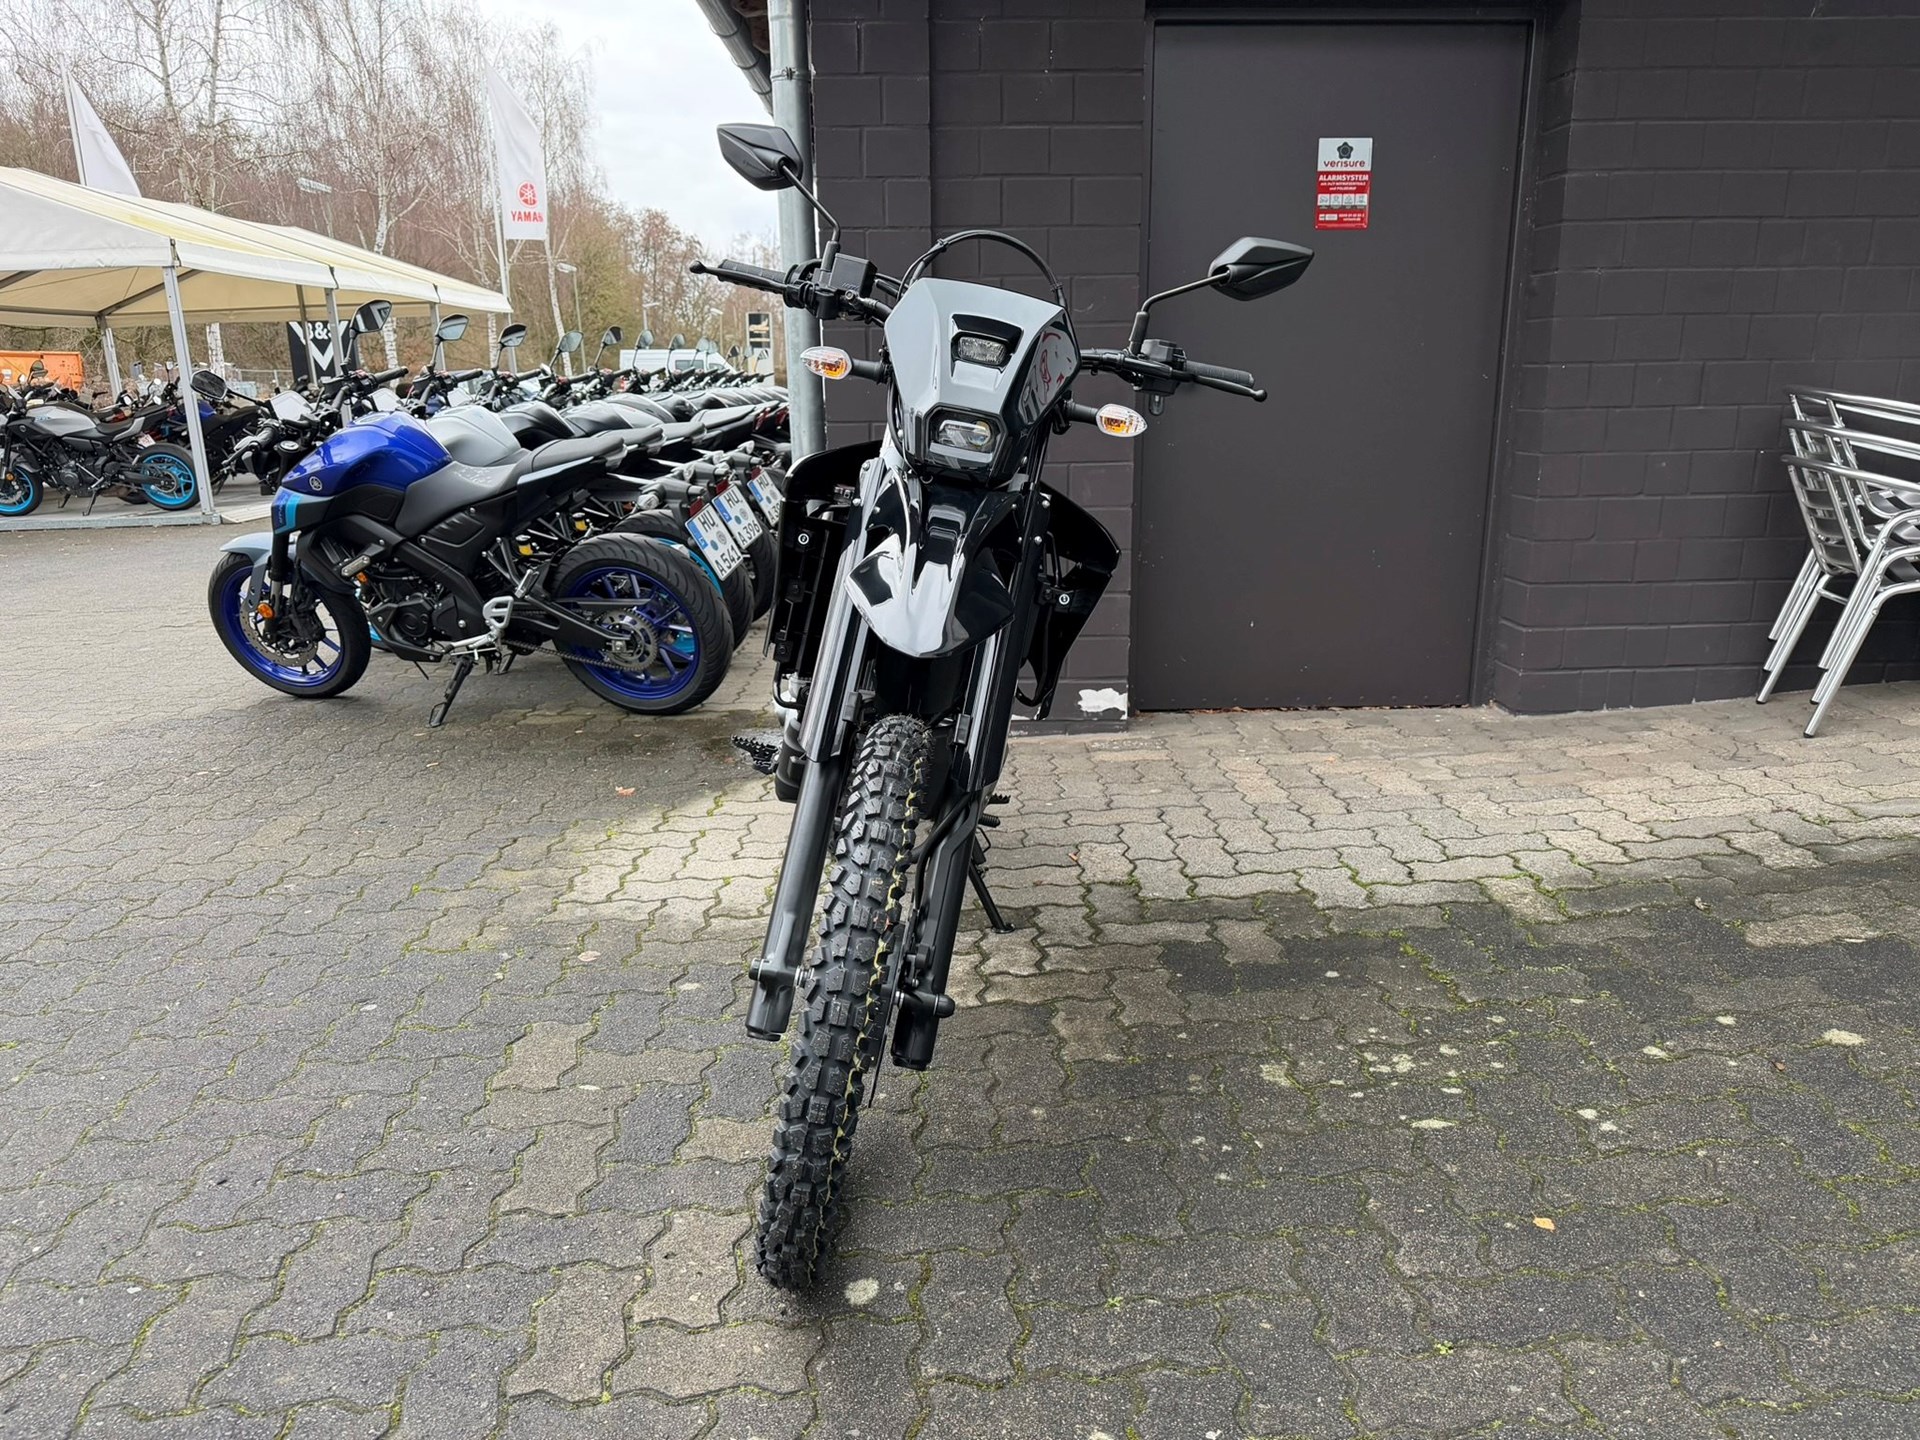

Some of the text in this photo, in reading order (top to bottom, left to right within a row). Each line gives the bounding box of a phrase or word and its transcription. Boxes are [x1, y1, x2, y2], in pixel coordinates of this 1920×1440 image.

[1323, 160, 1366, 168] verisure
[723, 489, 740, 508] HU
[697, 510, 716, 533] HU
[737, 519, 761, 545] A 396
[715, 544, 741, 576] A 541
